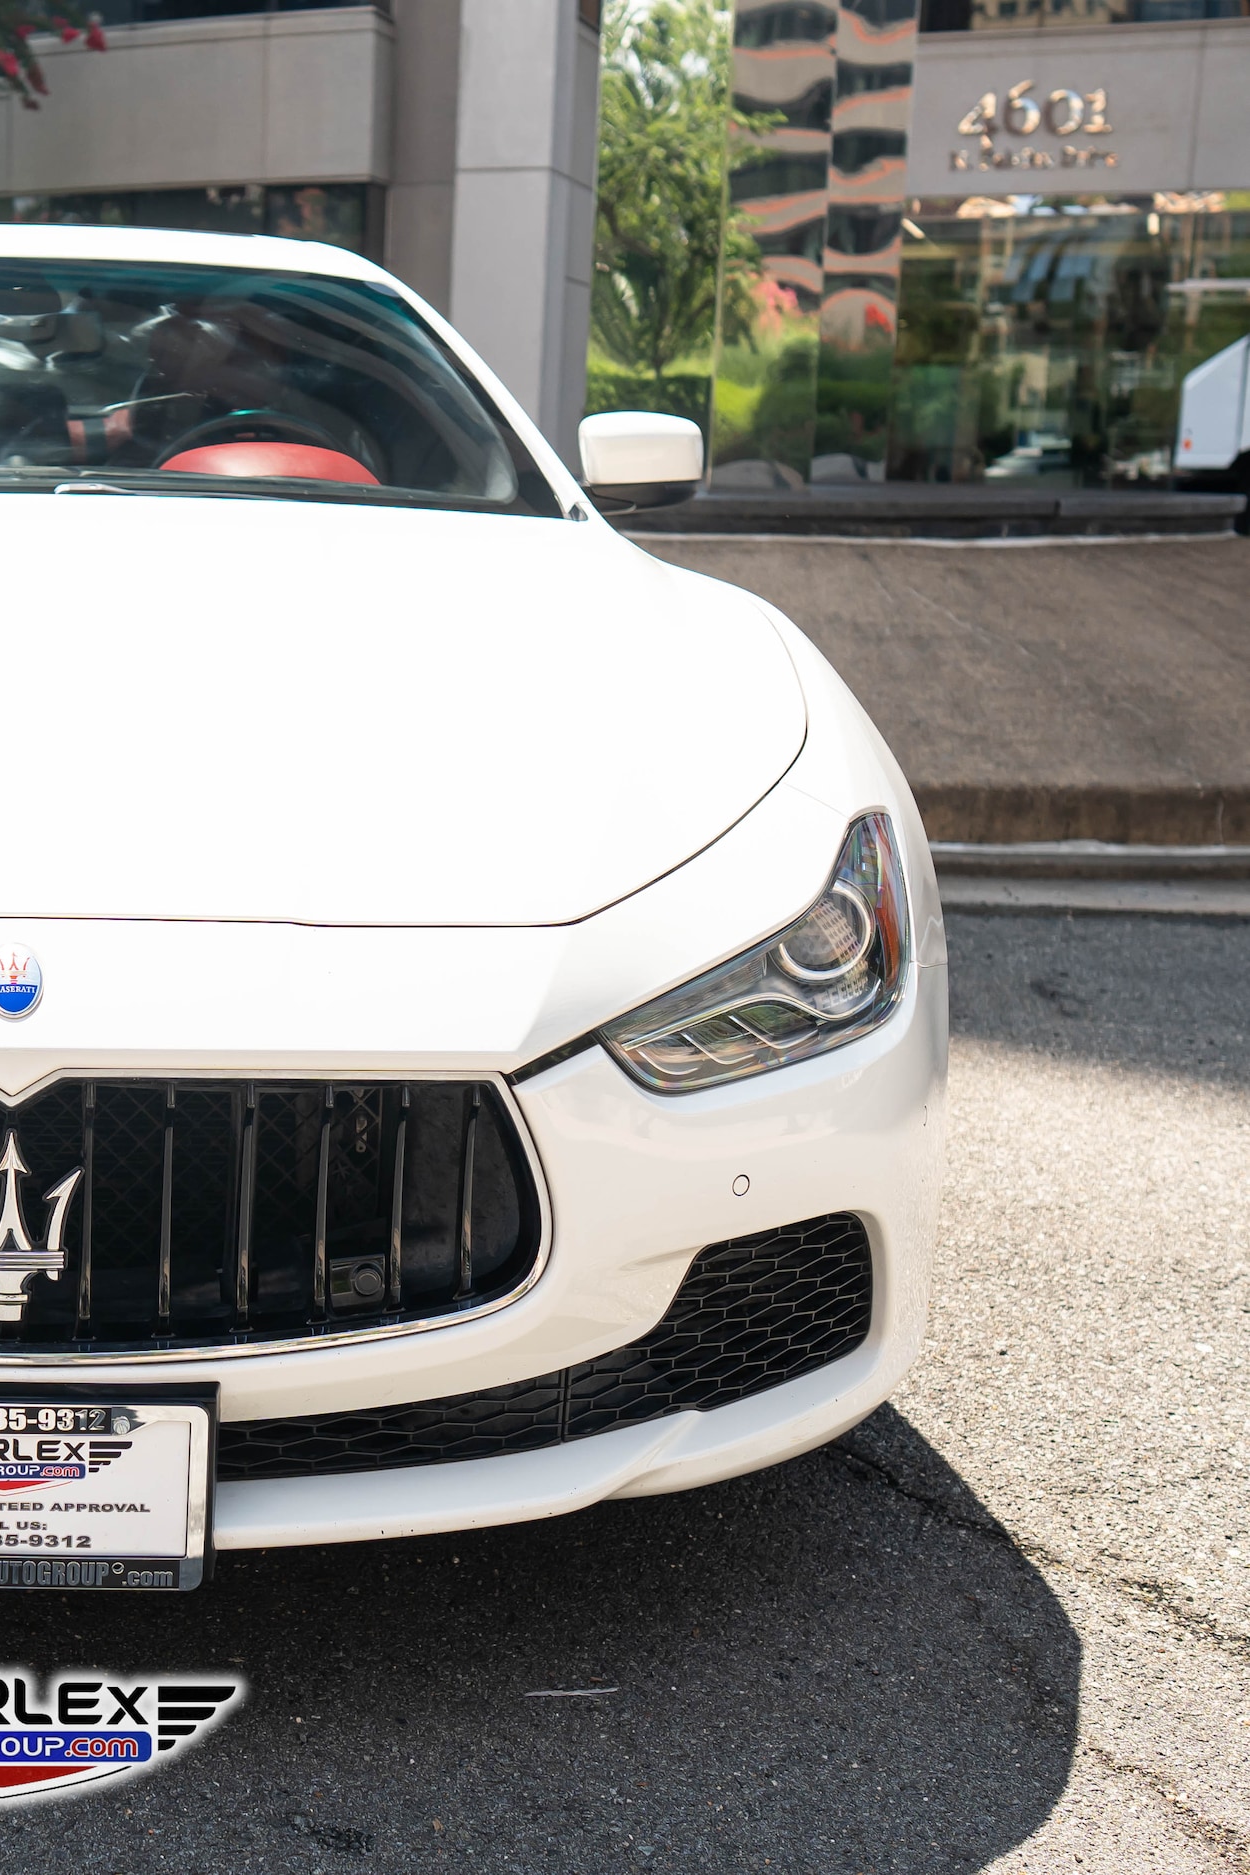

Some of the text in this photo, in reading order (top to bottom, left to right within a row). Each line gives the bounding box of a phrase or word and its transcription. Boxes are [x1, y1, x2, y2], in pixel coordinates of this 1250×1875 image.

[957, 79, 1113, 149] 4601
[50, 1502, 151, 1513] APPROVAL
[16, 1521, 48, 1531] US:
[121, 1570, 174, 1588] .com
